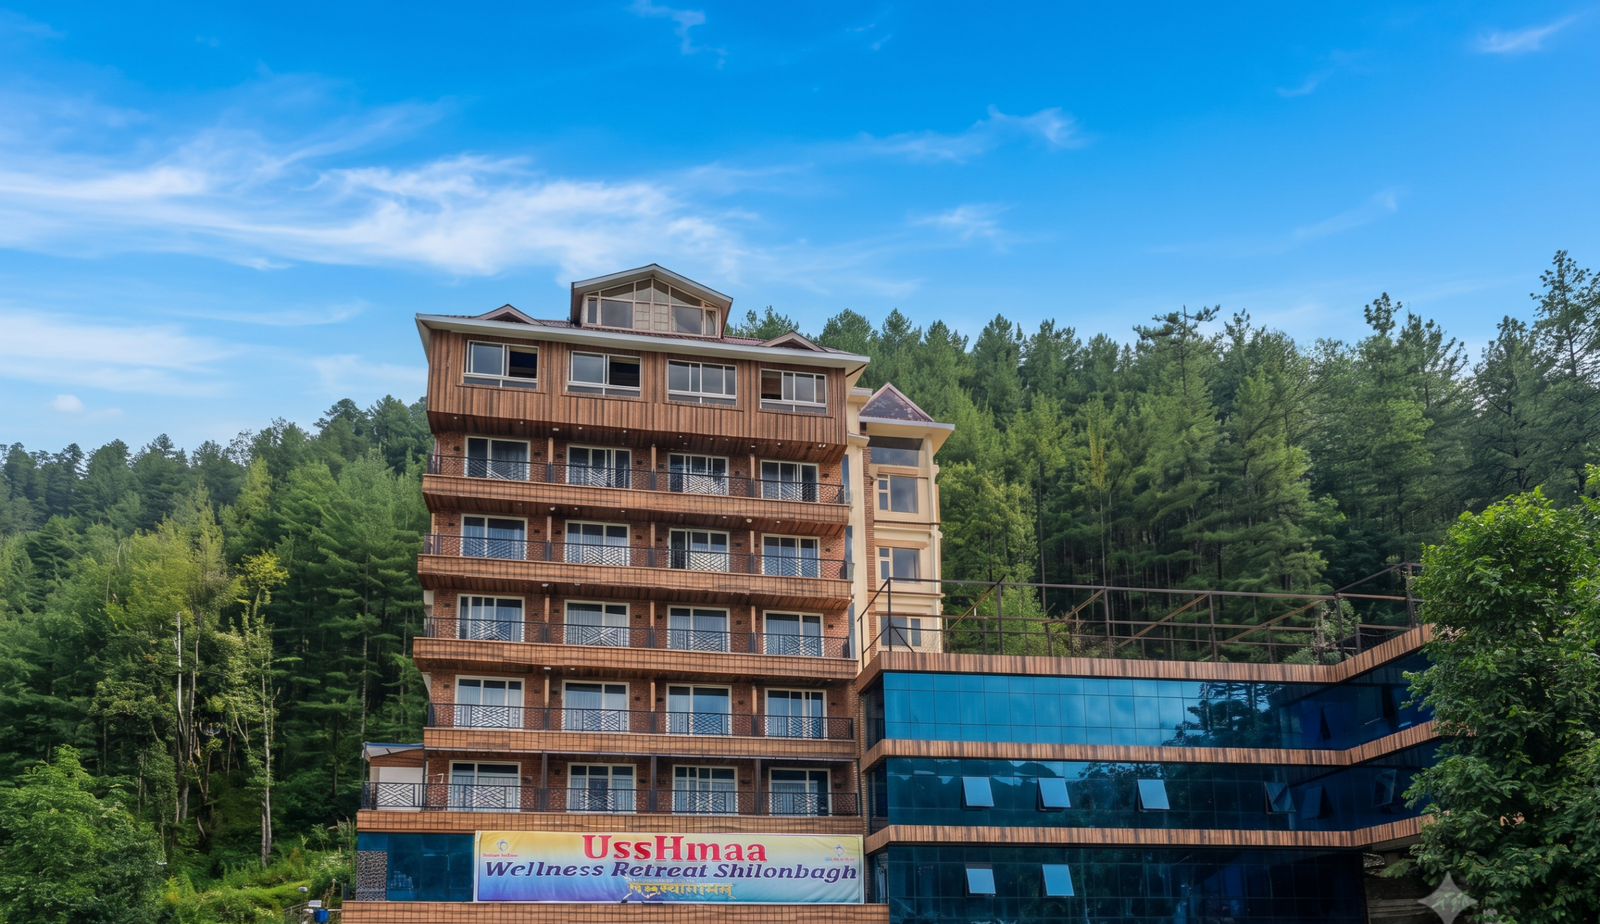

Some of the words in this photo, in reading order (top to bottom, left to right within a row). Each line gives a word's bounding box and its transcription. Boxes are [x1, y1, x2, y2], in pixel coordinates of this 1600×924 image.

[582, 835, 767, 862] UssHmaa
[486, 861, 604, 877] Wellness
[611, 862, 708, 878] Retreat
[713, 864, 857, 883] Shilonbagh
